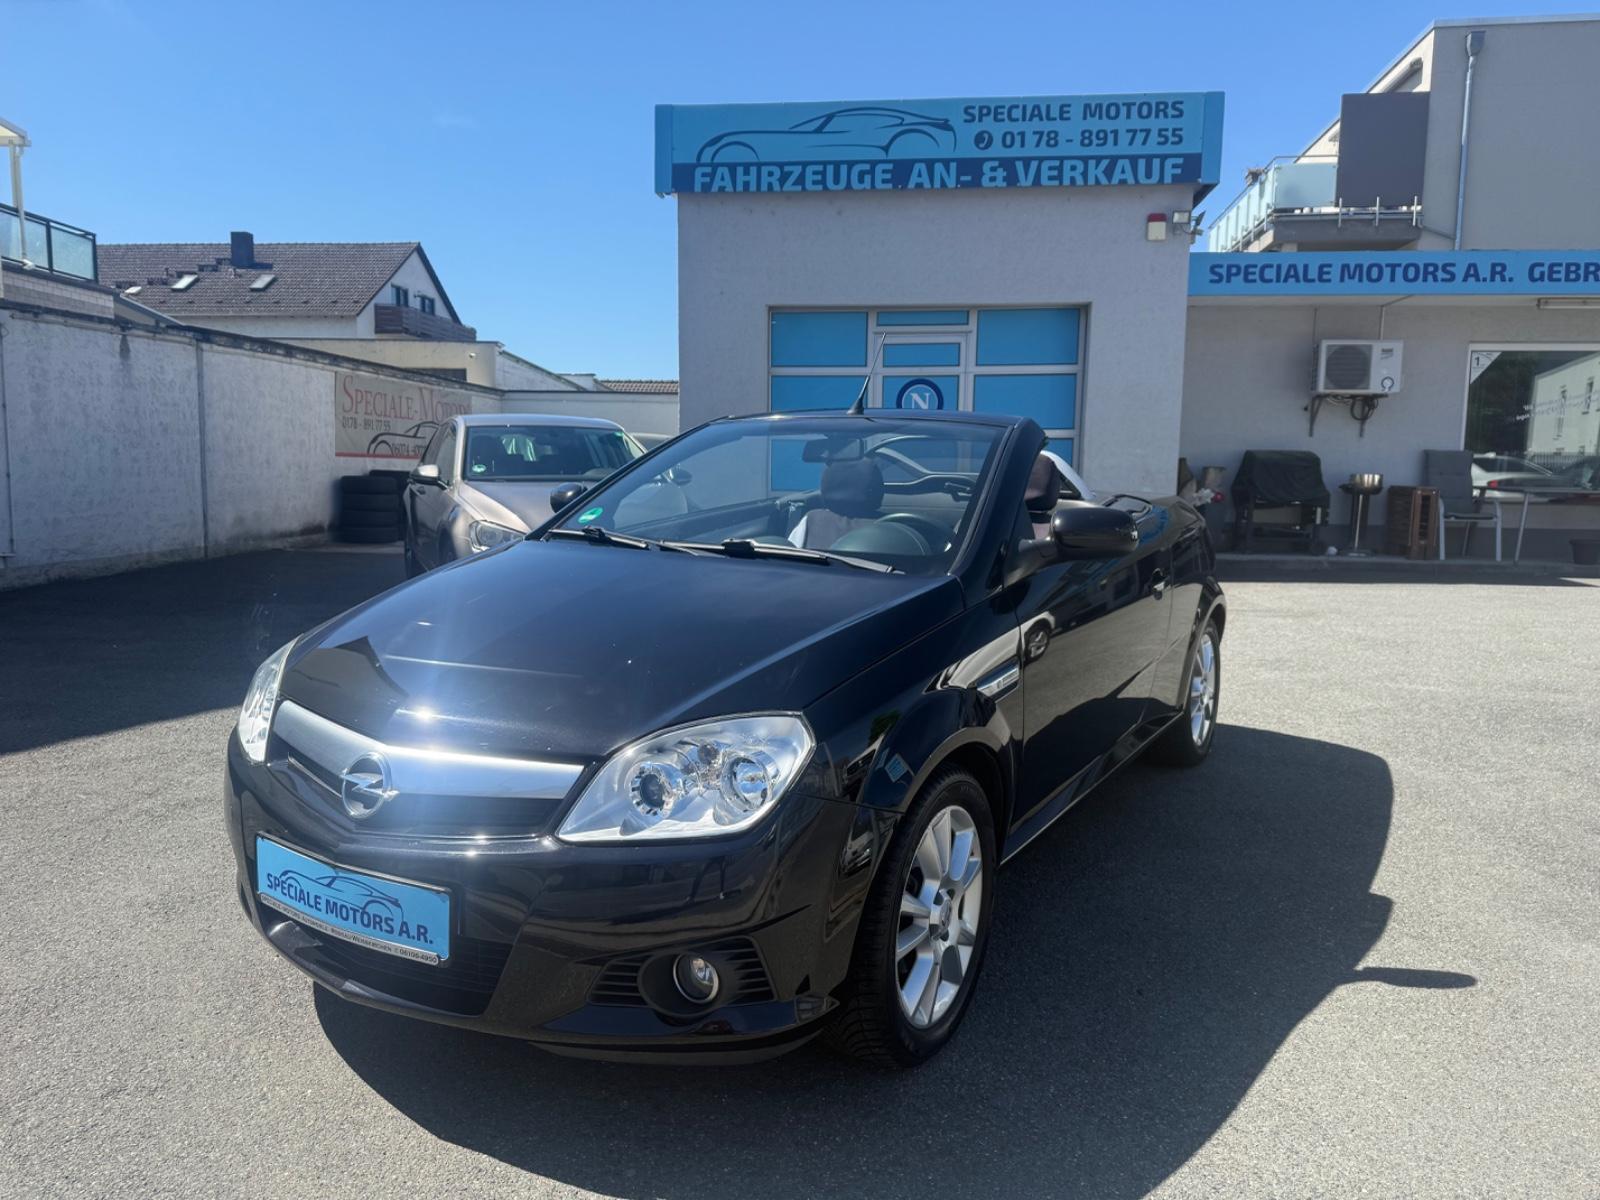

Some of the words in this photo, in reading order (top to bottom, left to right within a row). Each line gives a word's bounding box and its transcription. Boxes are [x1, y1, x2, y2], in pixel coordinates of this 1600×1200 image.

[963, 103, 1072, 123] SPECIALE
[1082, 100, 1184, 120] MOTORS
[1079, 129, 1118, 147] 891
[694, 162, 893, 193] FAHRZEUGE
[907, 161, 971, 189] AN-
[982, 160, 1007, 187] &
[1015, 157, 1184, 185] VERKAUF
[1208, 263, 1333, 284] SPECIALE
[1339, 262, 1456, 283] MOTORS
[1462, 262, 1514, 283] A.R.
[1528, 262, 1600, 282] GEBR
[267, 872, 322, 912] SPECIALE
[325, 898, 394, 935] MOTORS
[398, 921, 433, 944] A.R.
